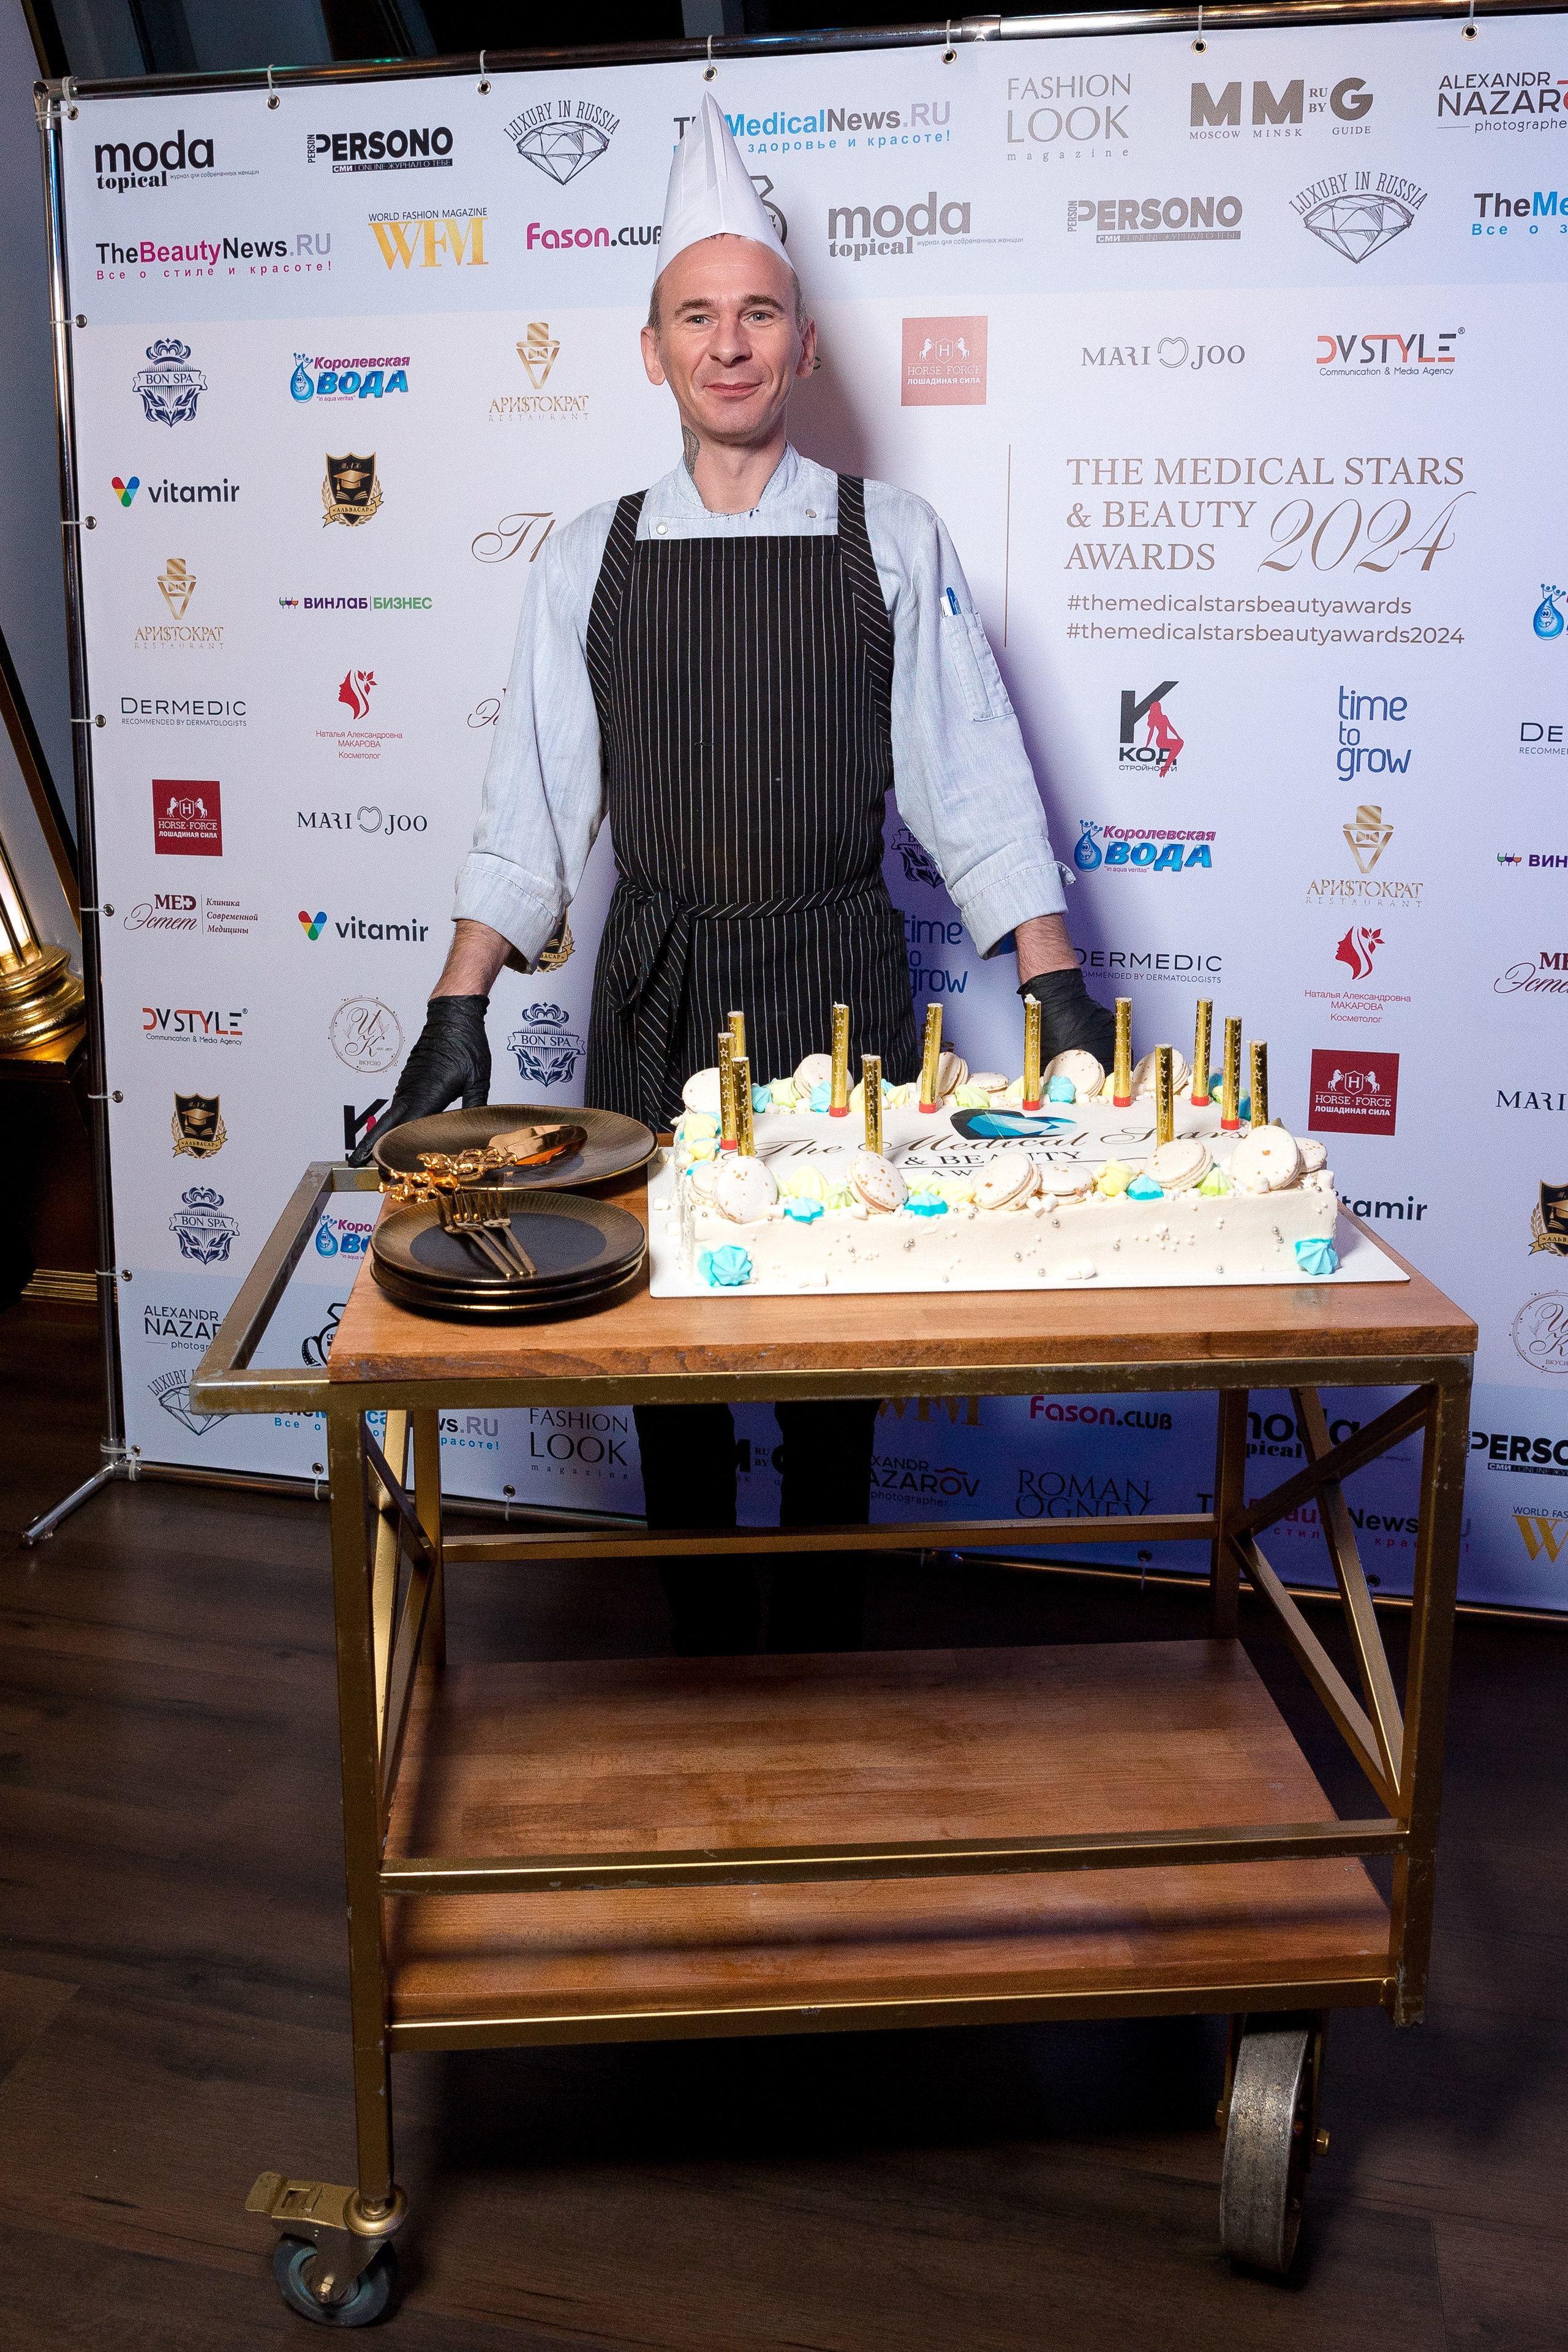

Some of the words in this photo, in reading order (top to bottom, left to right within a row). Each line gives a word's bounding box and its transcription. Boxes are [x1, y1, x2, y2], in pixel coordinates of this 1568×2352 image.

[1008, 74, 1131, 100] FASHION
[1439, 72, 1551, 90] ALEXANDR
[1310, 88, 1327, 98] RU
[1309, 103, 1327, 113] BY
[503, 103, 551, 141] LUXURY
[558, 100, 571, 118] IN
[578, 101, 620, 135] RUSSIA
[1008, 105, 1129, 143] LOOK
[748, 137, 837, 154] здоровье
[848, 137, 856, 148] и
[867, 130, 950, 148] красоте!
[1189, 130, 1241, 140] MOSCOW
[1253, 128, 1302, 138] MINSK
[1332, 126, 1371, 135] GUIDE
[95, 130, 214, 173] moda
[316, 127, 453, 162] PERSONO
[1008, 149, 1129, 162] magazine
[97, 171, 167, 193] topical
[1289, 173, 1348, 216] LUXURY
[1355, 172, 1371, 190] IN
[1376, 172, 1428, 211] RUSSIA
[369, 212, 399, 222] WORLD
[402, 209, 439, 221] FASHION
[442, 208, 487, 218] MAGAZINE
[828, 192, 970, 239] moda
[1068, 200, 1077, 232] PERSON
[1078, 196, 1242, 230] PERSONO
[1472, 224, 1508, 236] Все
[1529, 224, 1539, 235] о
[96, 233, 332, 266] TheBeautyNews.RU
[369, 217, 488, 270] WFM
[829, 238, 913, 261] topical
[97, 270, 126, 280] Все
[140, 270, 147, 279] о
[164, 267, 214, 277] стиле
[228, 266, 235, 276] и
[250, 261, 332, 274] красоте!
[314, 355, 410, 371] Королевская
[1082, 345, 1151, 366] MARI
[1191, 345, 1246, 370] JOO
[146, 374, 170, 386] BON
[173, 373, 194, 384] SPA
[907, 377, 957, 386] ЛОШАДИНАЯ
[959, 376, 981, 385] СИЛА
[1319, 367, 1381, 376] Communication
[1422, 367, 1453, 377] Agency
[316, 370, 409, 399] ВОДА
[489, 413, 589, 422] RESTAURANT
[1066, 458, 1143, 485] THE
[1154, 458, 1334, 485] MEDICAL
[1345, 457, 1464, 485] STARS
[148, 478, 239, 503] vitamir
[1066, 502, 1091, 528] &
[1102, 500, 1257, 528] BEAUTY
[1257, 491, 1477, 573] 2024
[1064, 543, 1215, 570] AWARDS
[373, 597, 432, 609] БИЗНЕС
[1067, 594, 1411, 617] #themedicalstarsbeautyawards
[1066, 623, 1464, 646] #themedicalstarsbeautyawards2024
[121, 697, 246, 715] DERMEDIC
[1339, 686, 1407, 720] time
[347, 731, 402, 740] Александровна
[1339, 722, 1360, 745] to
[338, 739, 381, 748] МАКАРОВА
[339, 752, 381, 760] Косметолог
[1119, 747, 1177, 766] КОД
[1336, 747, 1411, 781] grow
[298, 811, 352, 829] MARI
[385, 815, 428, 835] JOO
[159, 831, 198, 839] ЛОШАДИНАЯ
[1103, 825, 1216, 842] Королевская
[1104, 842, 1212, 872] ВОДА
[206, 898, 239, 907] Клиника
[1306, 896, 1423, 908] RESTAURANT
[207, 911, 258, 921] Современной
[207, 925, 249, 934] Медицины
[335, 916, 429, 941] vitamir
[1146, 974, 1221, 983] DERMATOLOGISTS
[1305, 990, 1340, 999] Наталья
[1343, 990, 1411, 1002] Александровна
[1331, 1001, 1384, 1011] МАКАРОВА
[1330, 1013, 1382, 1023] Косметолог
[146, 1033, 190, 1042] Communication
[219, 1038, 243, 1046] Agency
[521, 1035, 546, 1045] BON
[550, 1037, 571, 1047] SPA
[1314, 1105, 1366, 1115] ЛОШАДИНАЯ
[905, 1156, 927, 1165] &
[181, 1216, 204, 1226] BON
[207, 1218, 227, 1229] SPA
[144, 1305, 219, 1321] ALEXANDR
[147, 1370, 187, 1396] LUXURY
[530, 1408, 628, 1434] FASHION
[1030, 1396, 1172, 1430] Fason.CLUB
[274, 1417, 300, 1428] Все
[530, 1431, 628, 1466] LOOK
[531, 1464, 629, 1480] magazine
[1019, 1469, 1152, 1504] ROMAN
[1513, 1506, 1548, 1517] WORLD
